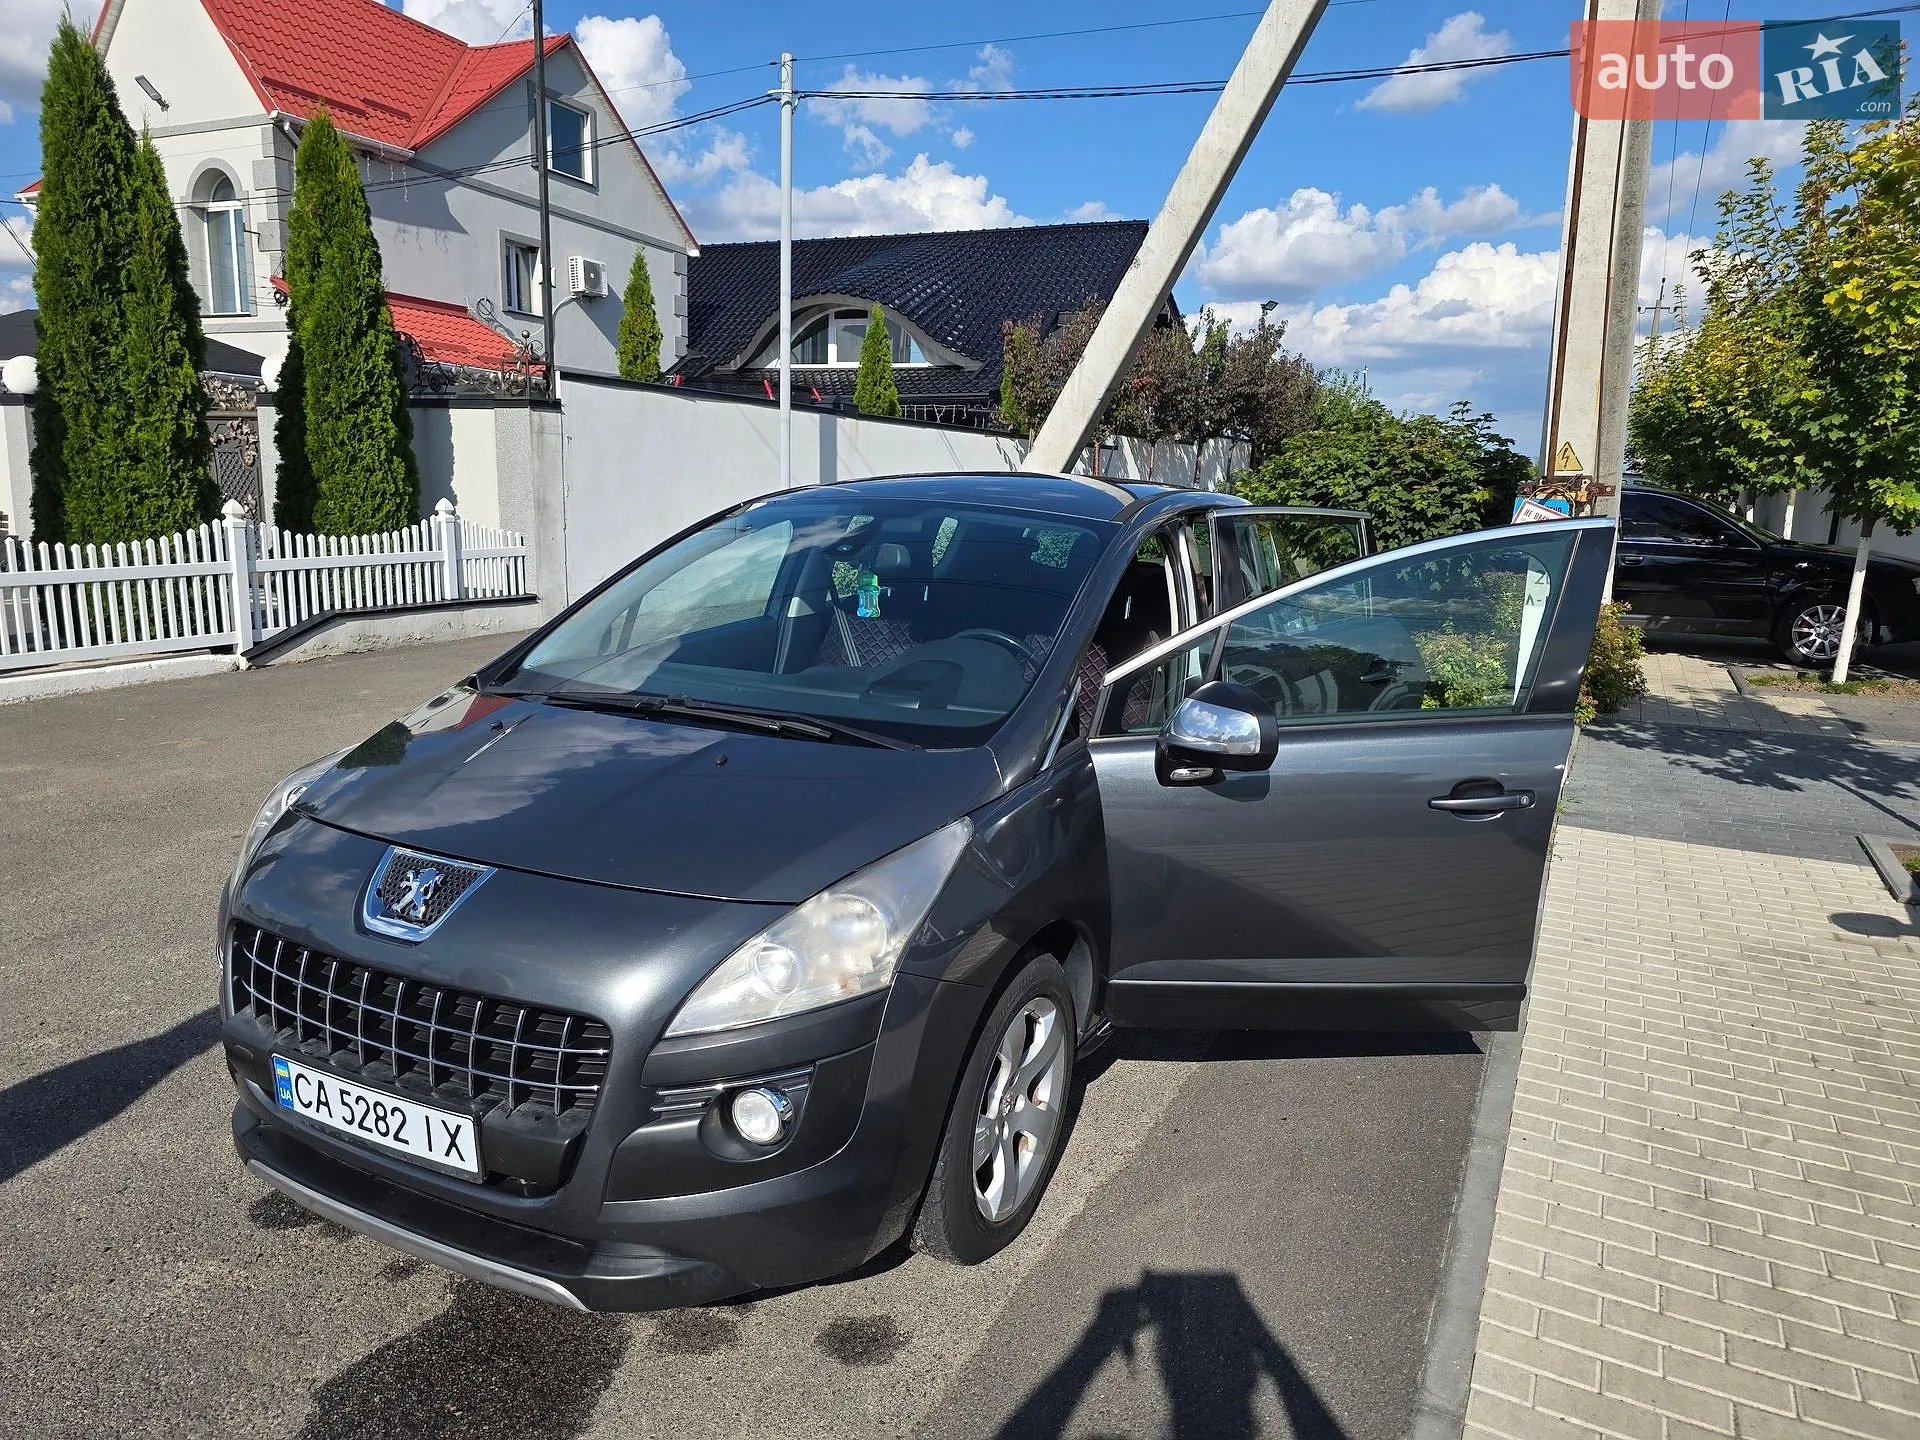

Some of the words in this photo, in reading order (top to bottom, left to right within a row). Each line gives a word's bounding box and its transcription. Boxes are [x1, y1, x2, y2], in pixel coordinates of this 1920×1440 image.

[279, 1087, 293, 1102] UA
[294, 1072, 334, 1119] CA
[339, 1087, 410, 1146] 5282
[424, 1115, 466, 1163] IX
